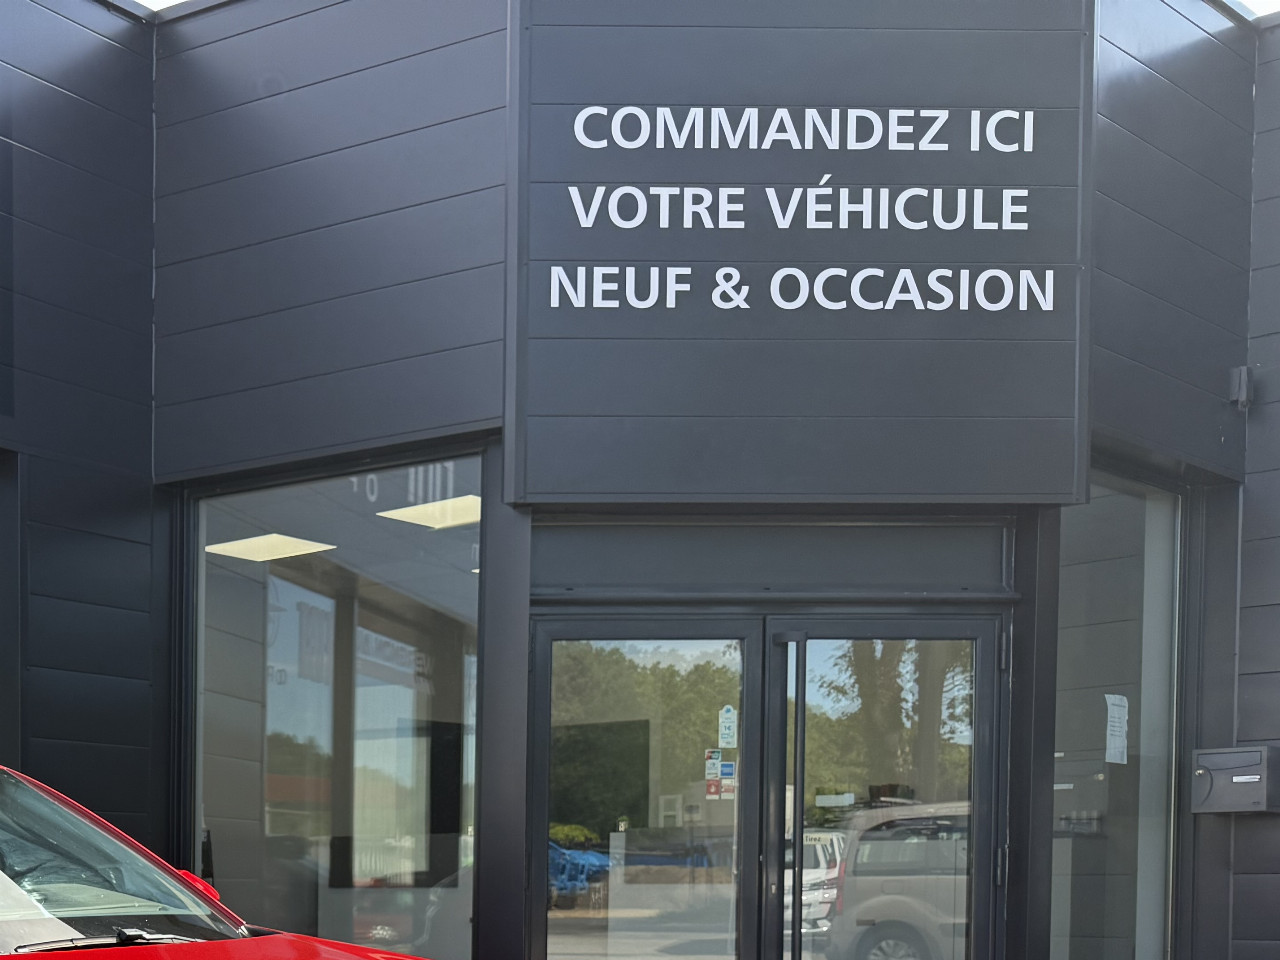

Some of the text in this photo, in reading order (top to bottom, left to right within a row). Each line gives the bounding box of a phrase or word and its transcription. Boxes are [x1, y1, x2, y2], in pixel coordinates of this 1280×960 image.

[573, 106, 1034, 153] COMMANDEZ ICI
[568, 174, 1030, 231] VOTRE VÉHICULE
[549, 265, 1055, 312] NEUF & OCCASION
